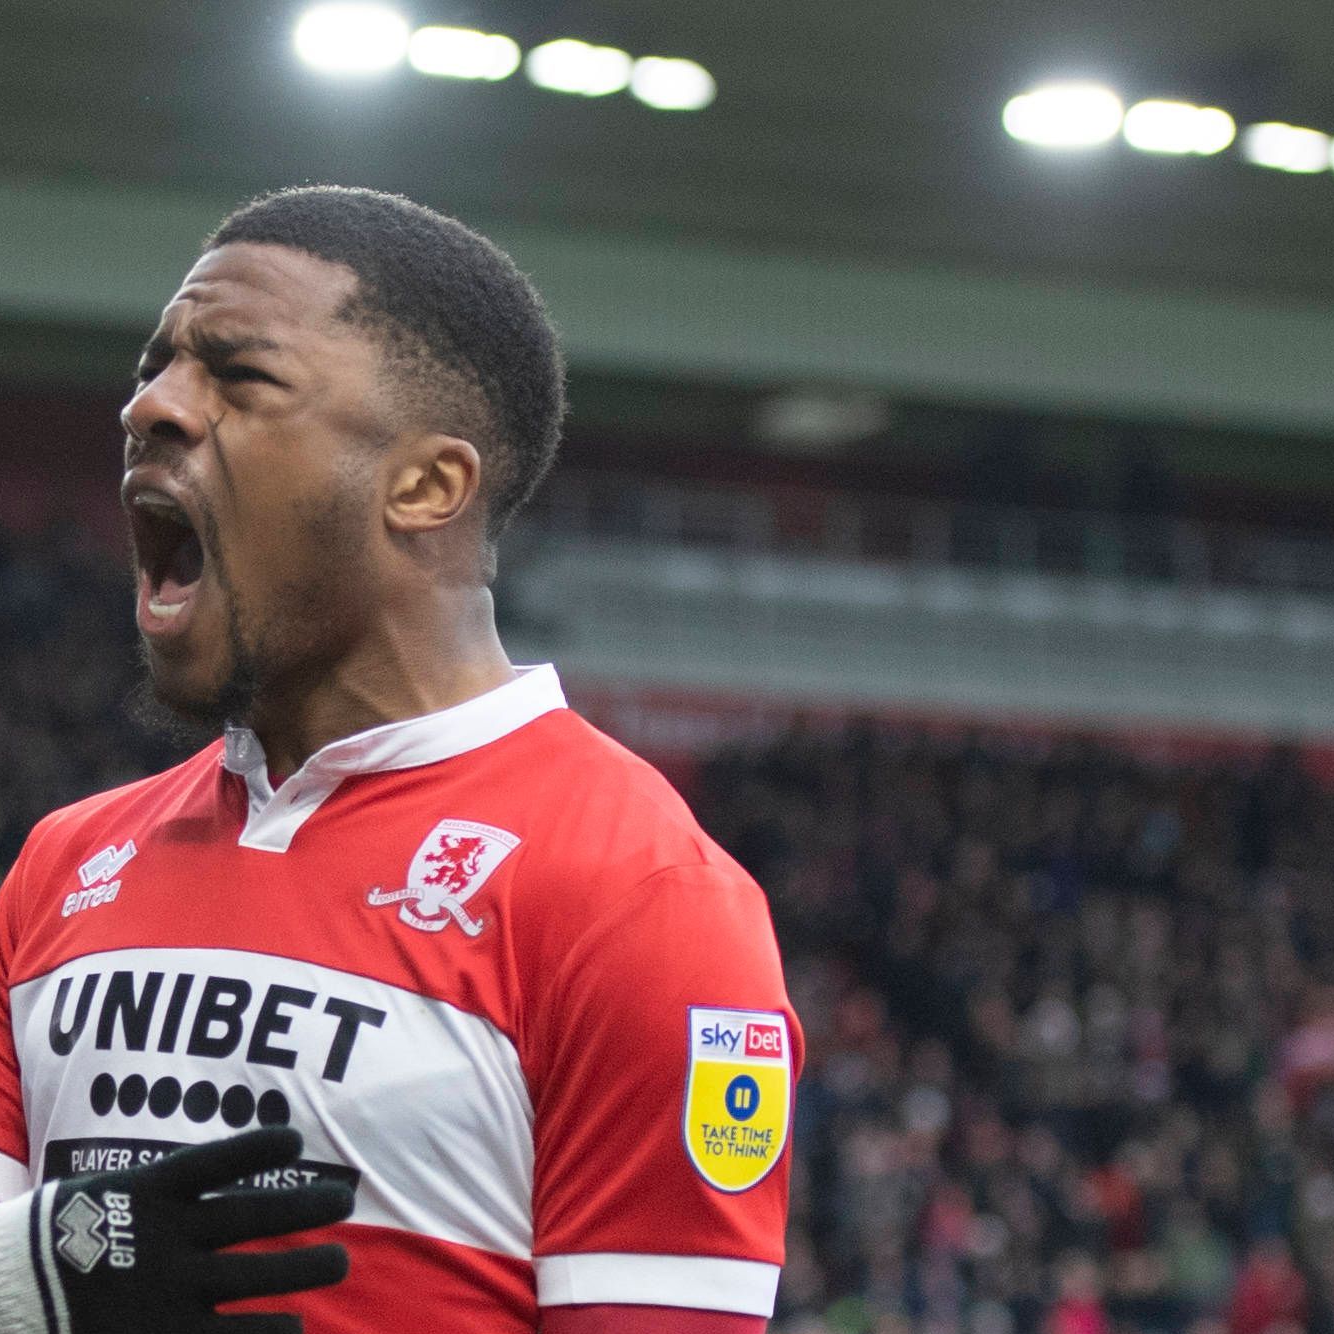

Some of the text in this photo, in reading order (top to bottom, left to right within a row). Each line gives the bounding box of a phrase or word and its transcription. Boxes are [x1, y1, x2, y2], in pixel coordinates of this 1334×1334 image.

[60, 879, 122, 918] errea
[48, 970, 388, 1083] UNIBET
[701, 1023, 781, 1052] sky bet
[701, 1124, 774, 1143] TAKE TIME
[705, 1140, 724, 1156] TO
[71, 1148, 133, 1173] PLAYER
[237, 1168, 319, 1189] IRST
[105, 1190, 136, 1269] errea
